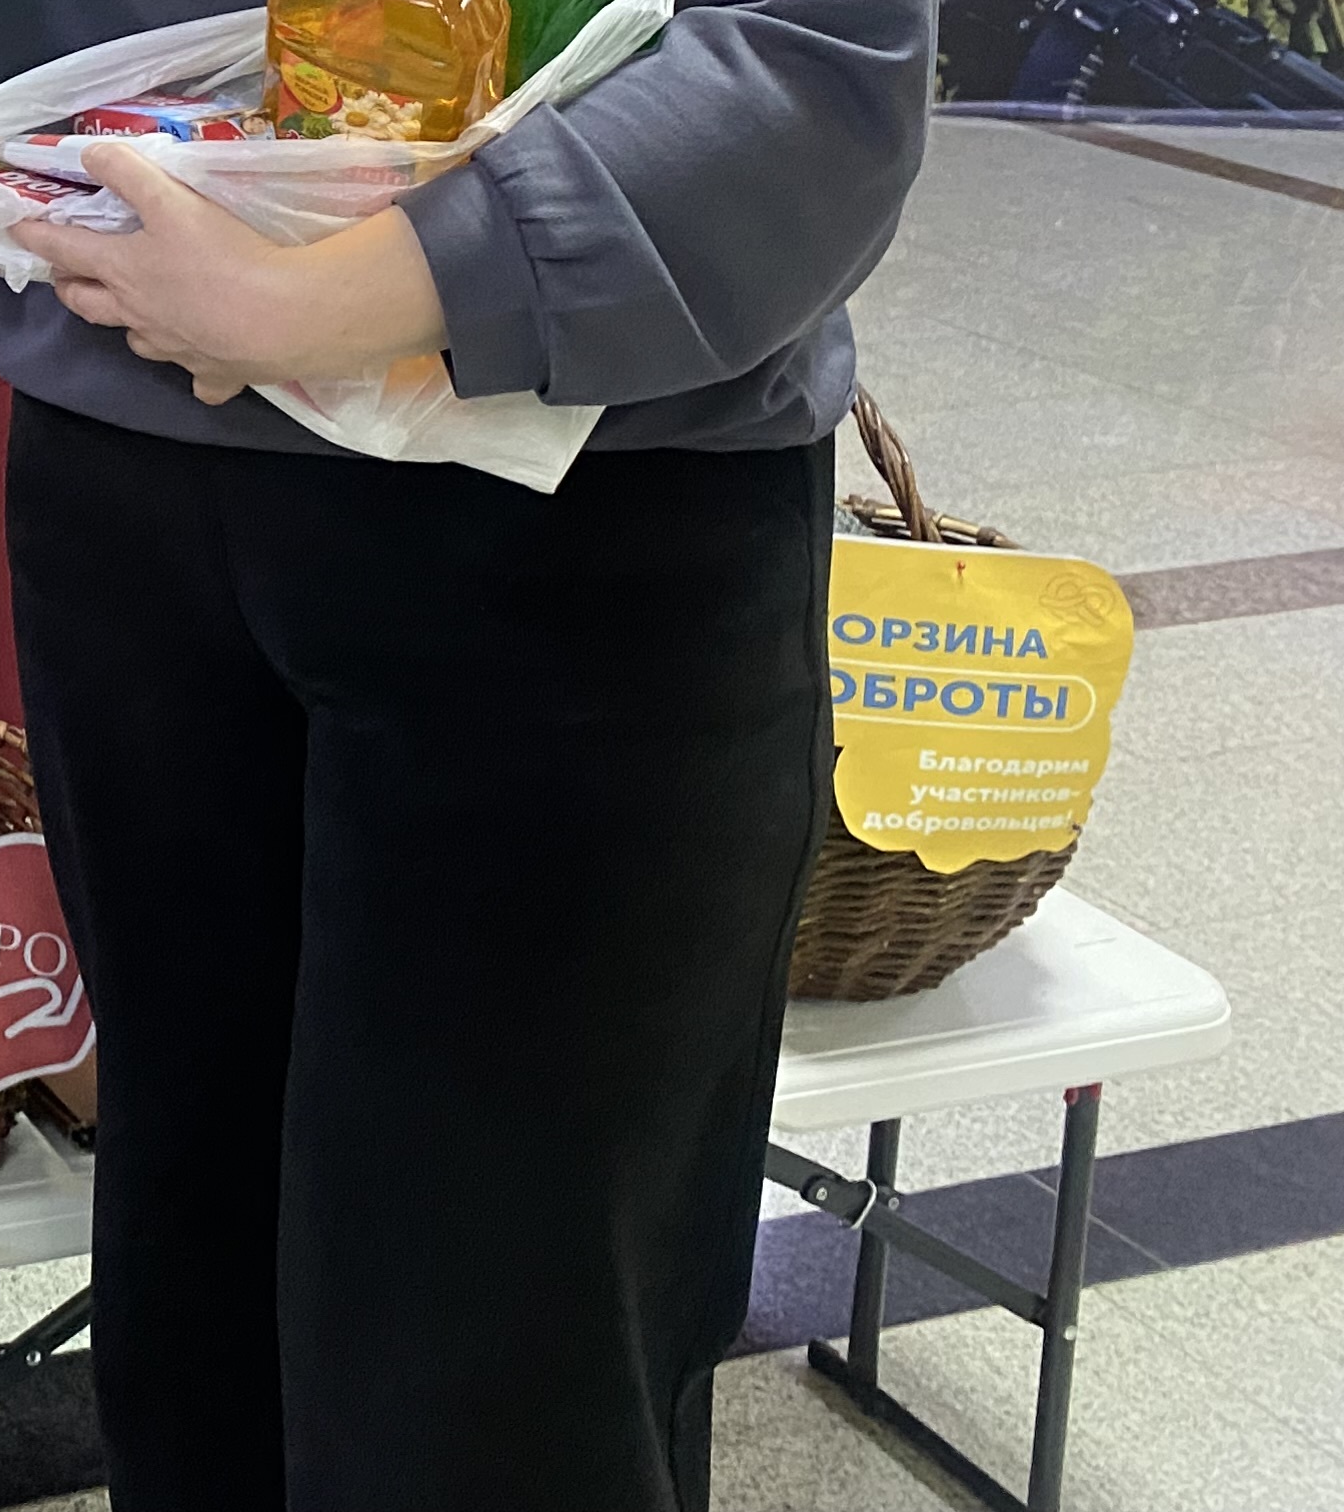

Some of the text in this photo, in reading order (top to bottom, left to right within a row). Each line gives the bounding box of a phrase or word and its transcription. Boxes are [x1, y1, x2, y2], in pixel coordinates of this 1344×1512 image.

[832, 614, 1049, 660] ОРЗИНА
[830, 669, 1069, 720] ОБРОТЫ
[919, 749, 1089, 776] Благодарим
[910, 782, 1080, 806] участников-
[863, 810, 1073, 836] добровольцев!
